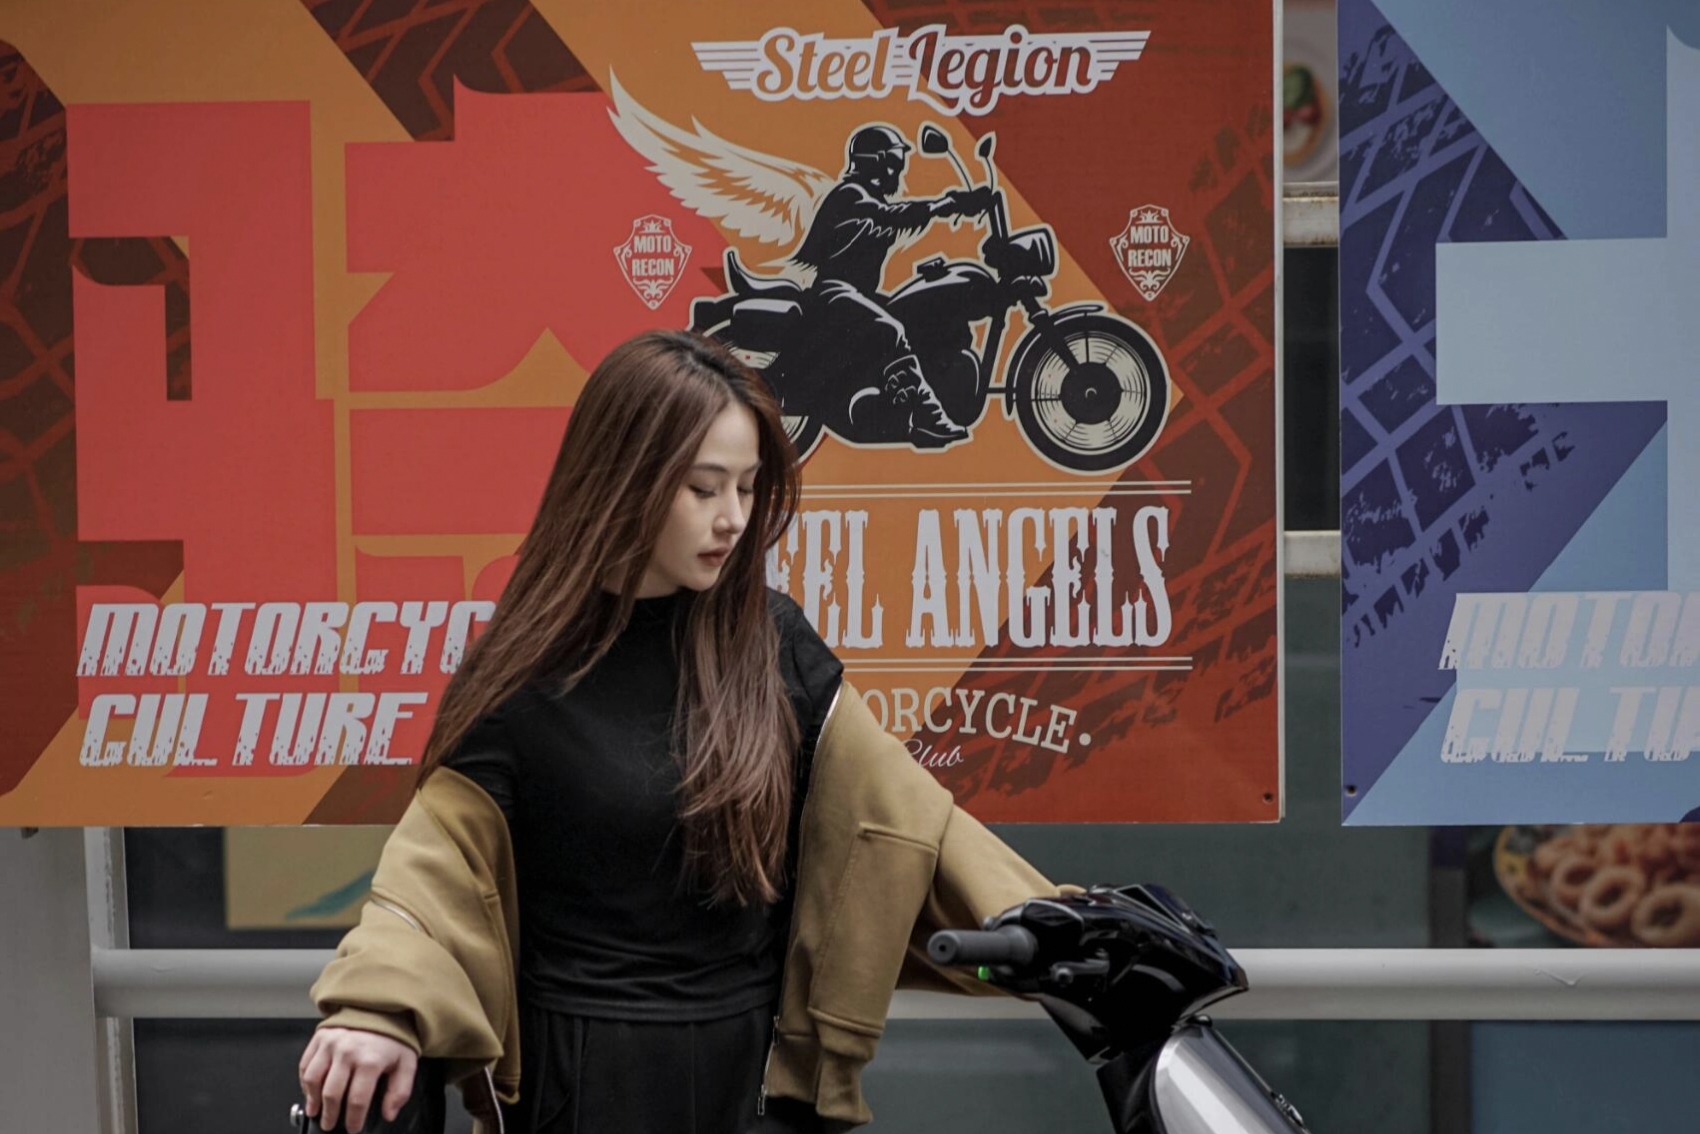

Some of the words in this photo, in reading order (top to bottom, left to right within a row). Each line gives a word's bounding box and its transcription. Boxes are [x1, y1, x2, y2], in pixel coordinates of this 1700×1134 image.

[754, 30, 896, 98] Steel
[908, 27, 1097, 113] Legion
[633, 235, 671, 253] MOTO
[1128, 249, 1171, 267] RECON
[1130, 226, 1169, 244] MOTO
[632, 258, 674, 276] RECON
[905, 506, 1172, 648] ANGELS
[76, 601, 496, 677] MOTORCYC
[79, 692, 428, 767] CULTURE
